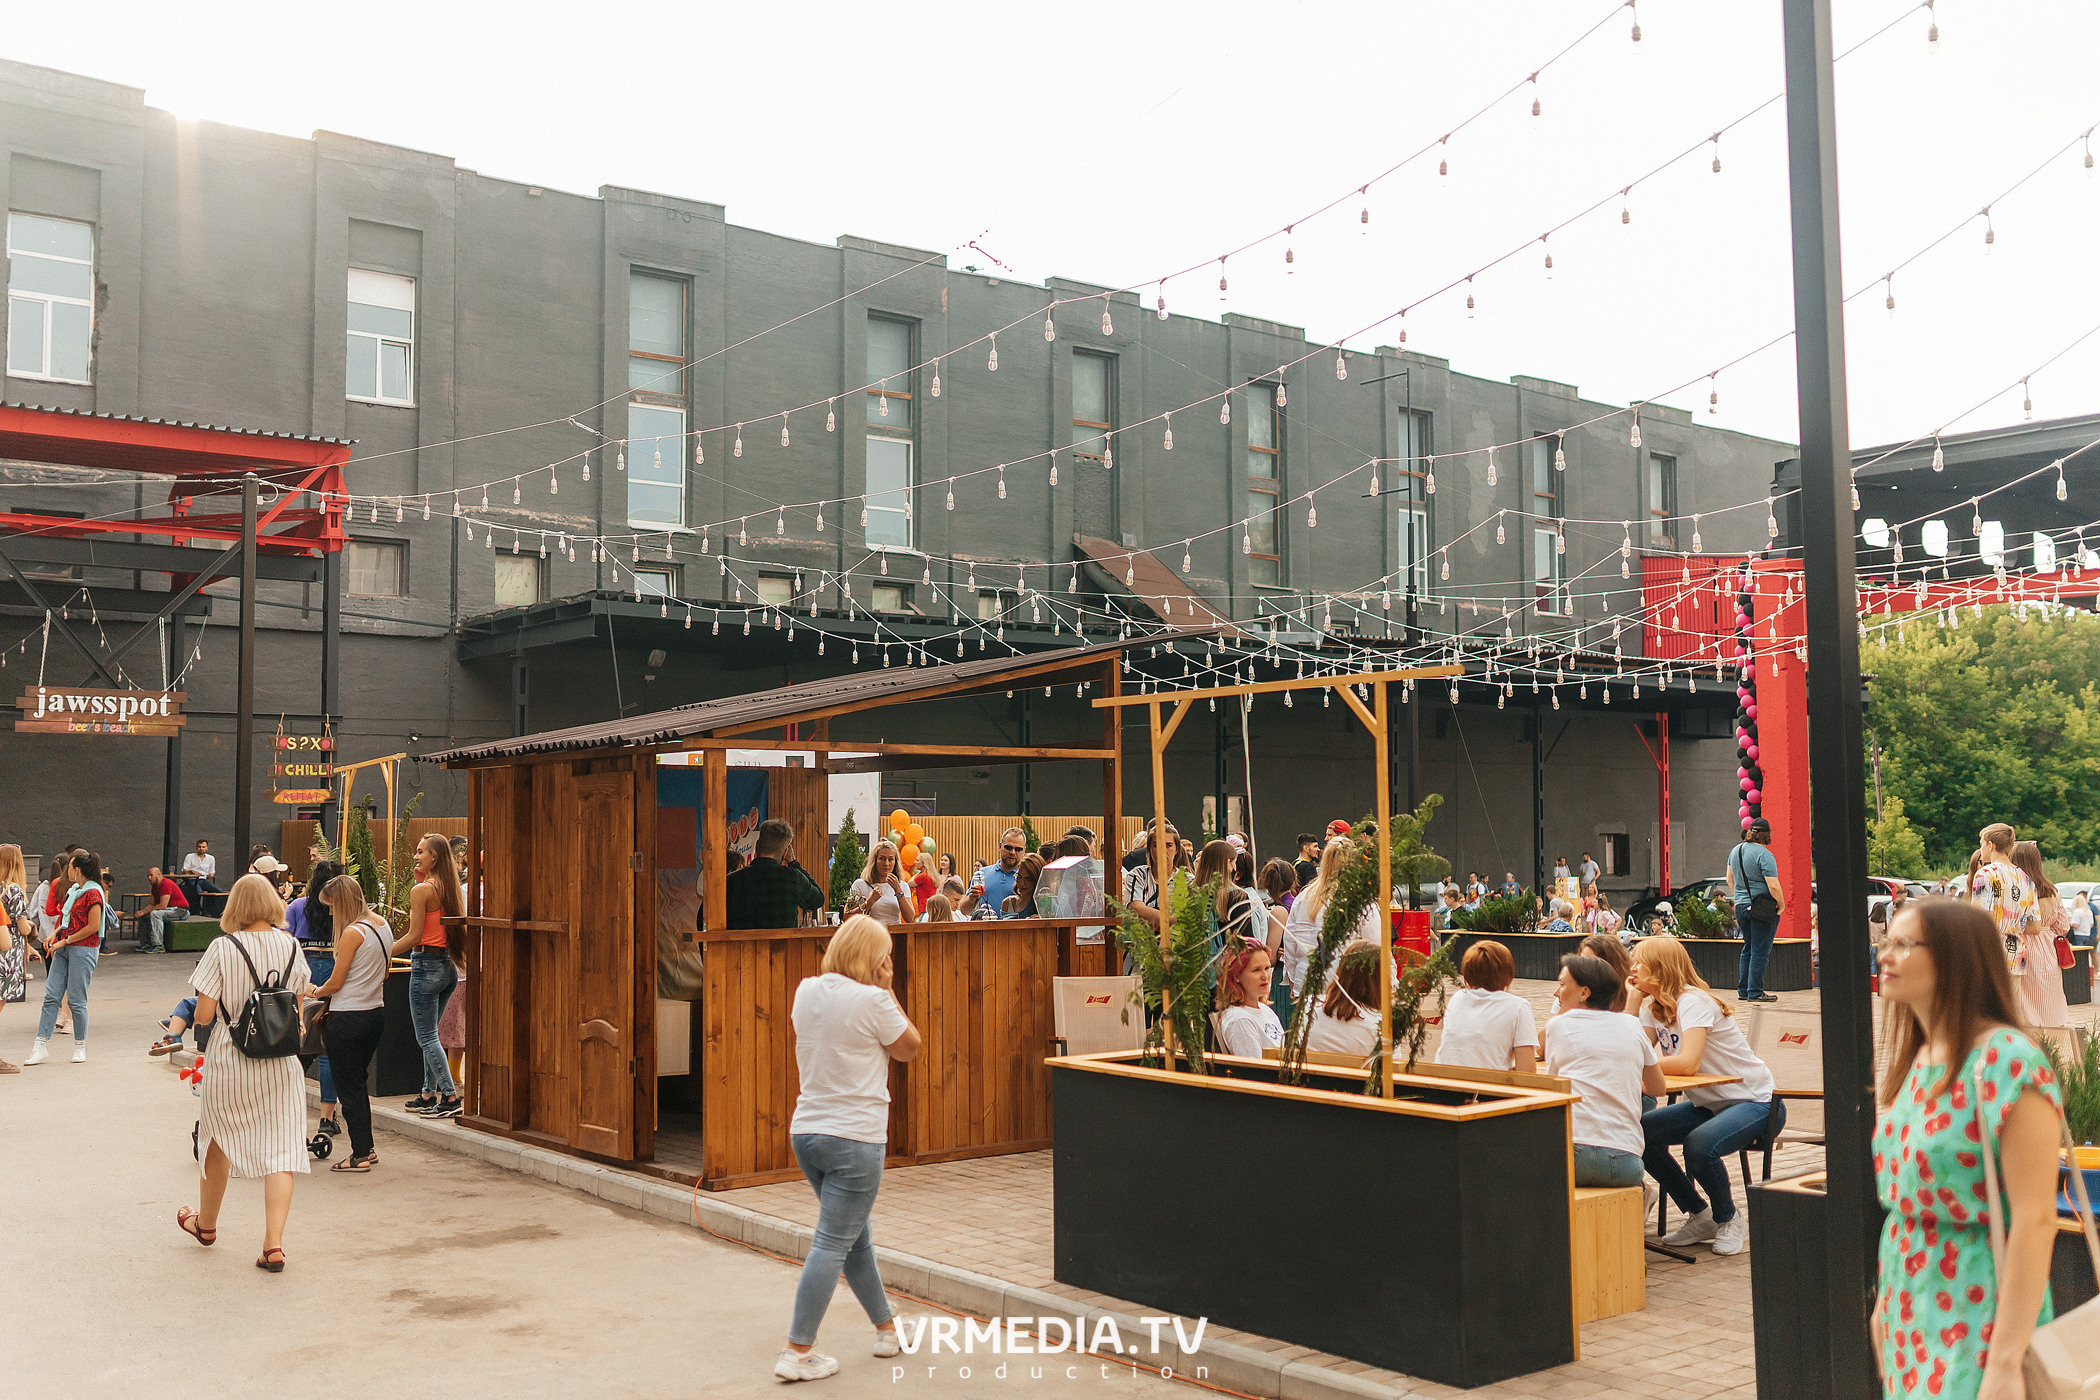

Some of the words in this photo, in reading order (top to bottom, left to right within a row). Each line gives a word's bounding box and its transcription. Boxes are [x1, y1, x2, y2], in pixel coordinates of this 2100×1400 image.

[33, 687, 171, 722] jawsspot
[68, 717, 100, 732] beer's
[103, 719, 135, 733] beach
[286, 736, 321, 750] S?X
[282, 792, 321, 802] REPEAT
[726, 808, 758, 845] OME
